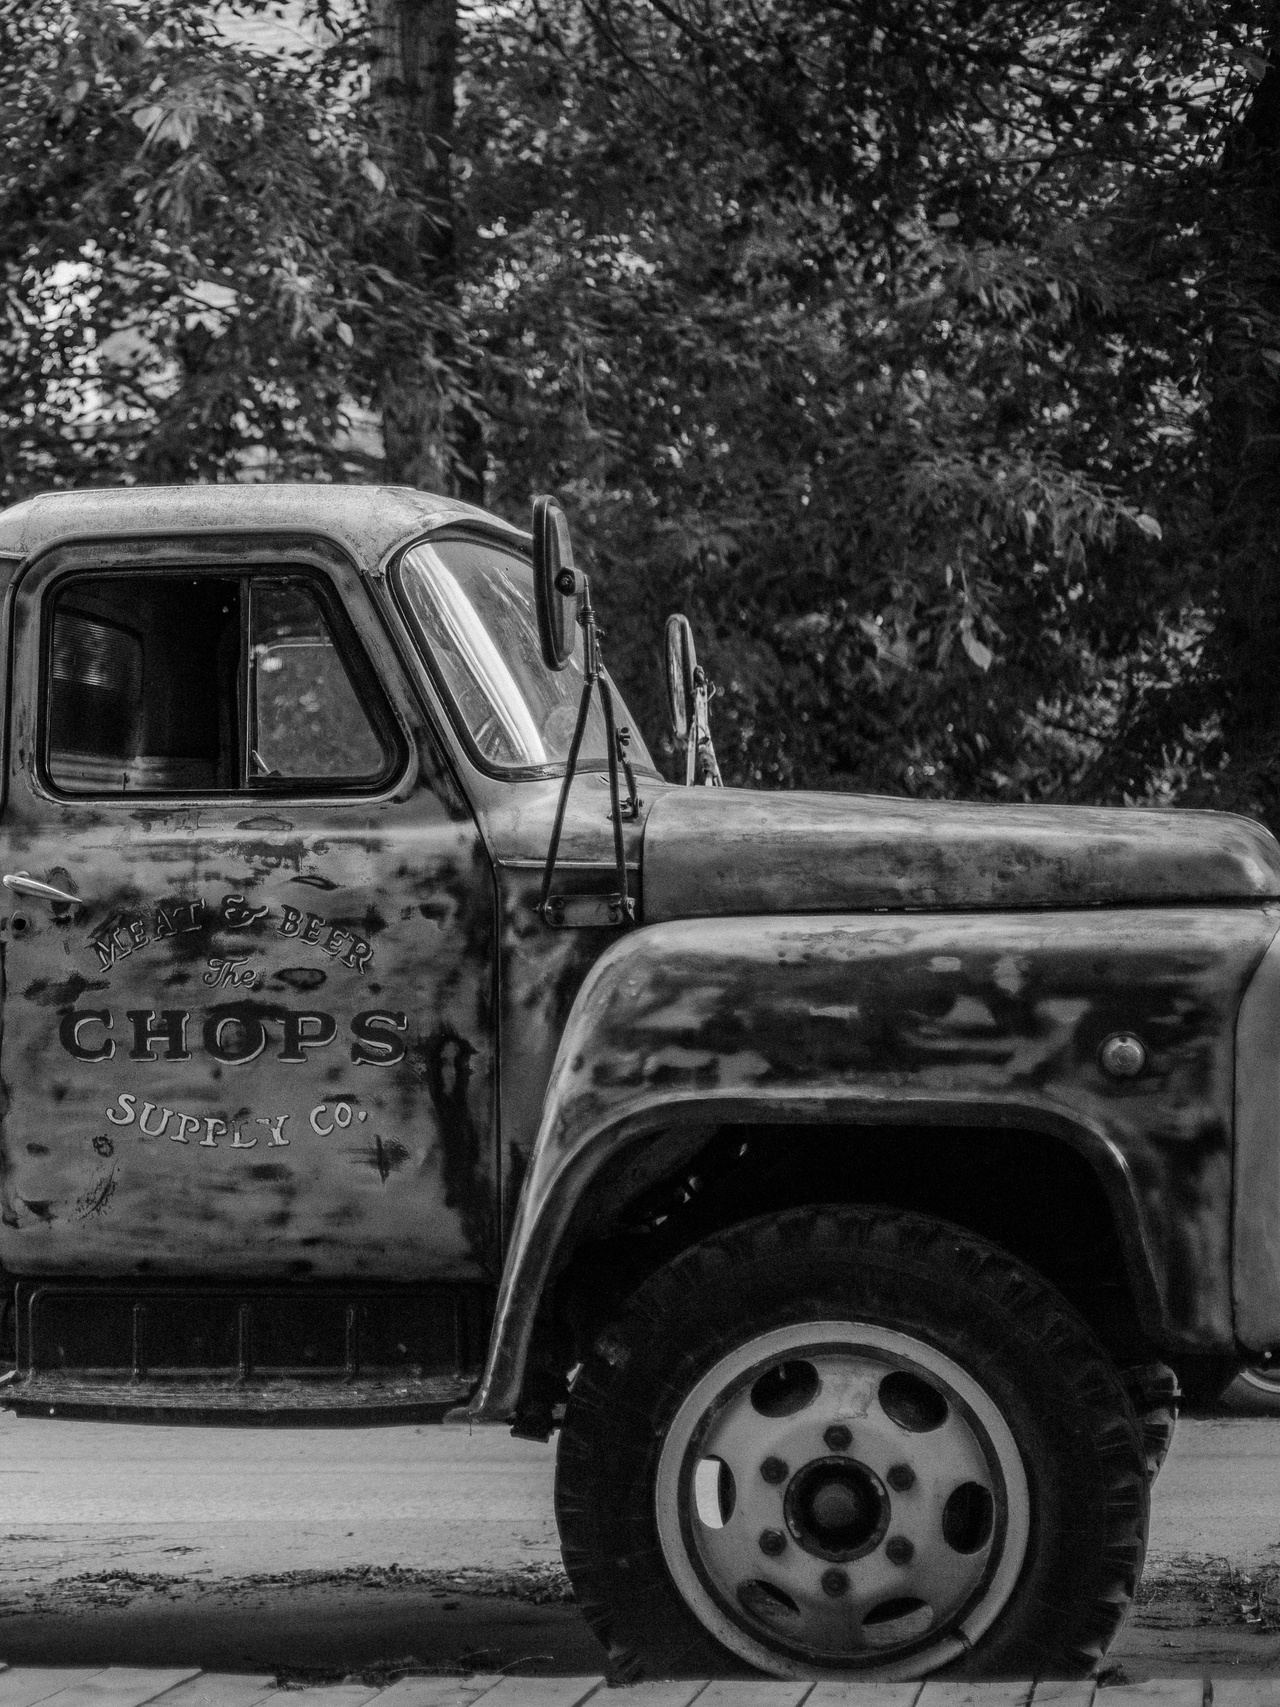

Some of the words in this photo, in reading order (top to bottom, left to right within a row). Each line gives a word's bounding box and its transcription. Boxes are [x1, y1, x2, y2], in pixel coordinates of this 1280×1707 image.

[88, 899, 206, 973] MEAT
[221, 894, 269, 927] &
[277, 904, 374, 974] BEER
[202, 957, 258, 988] The
[59, 1009, 408, 1066] CHOPS
[105, 1093, 290, 1149] SUPPLY
